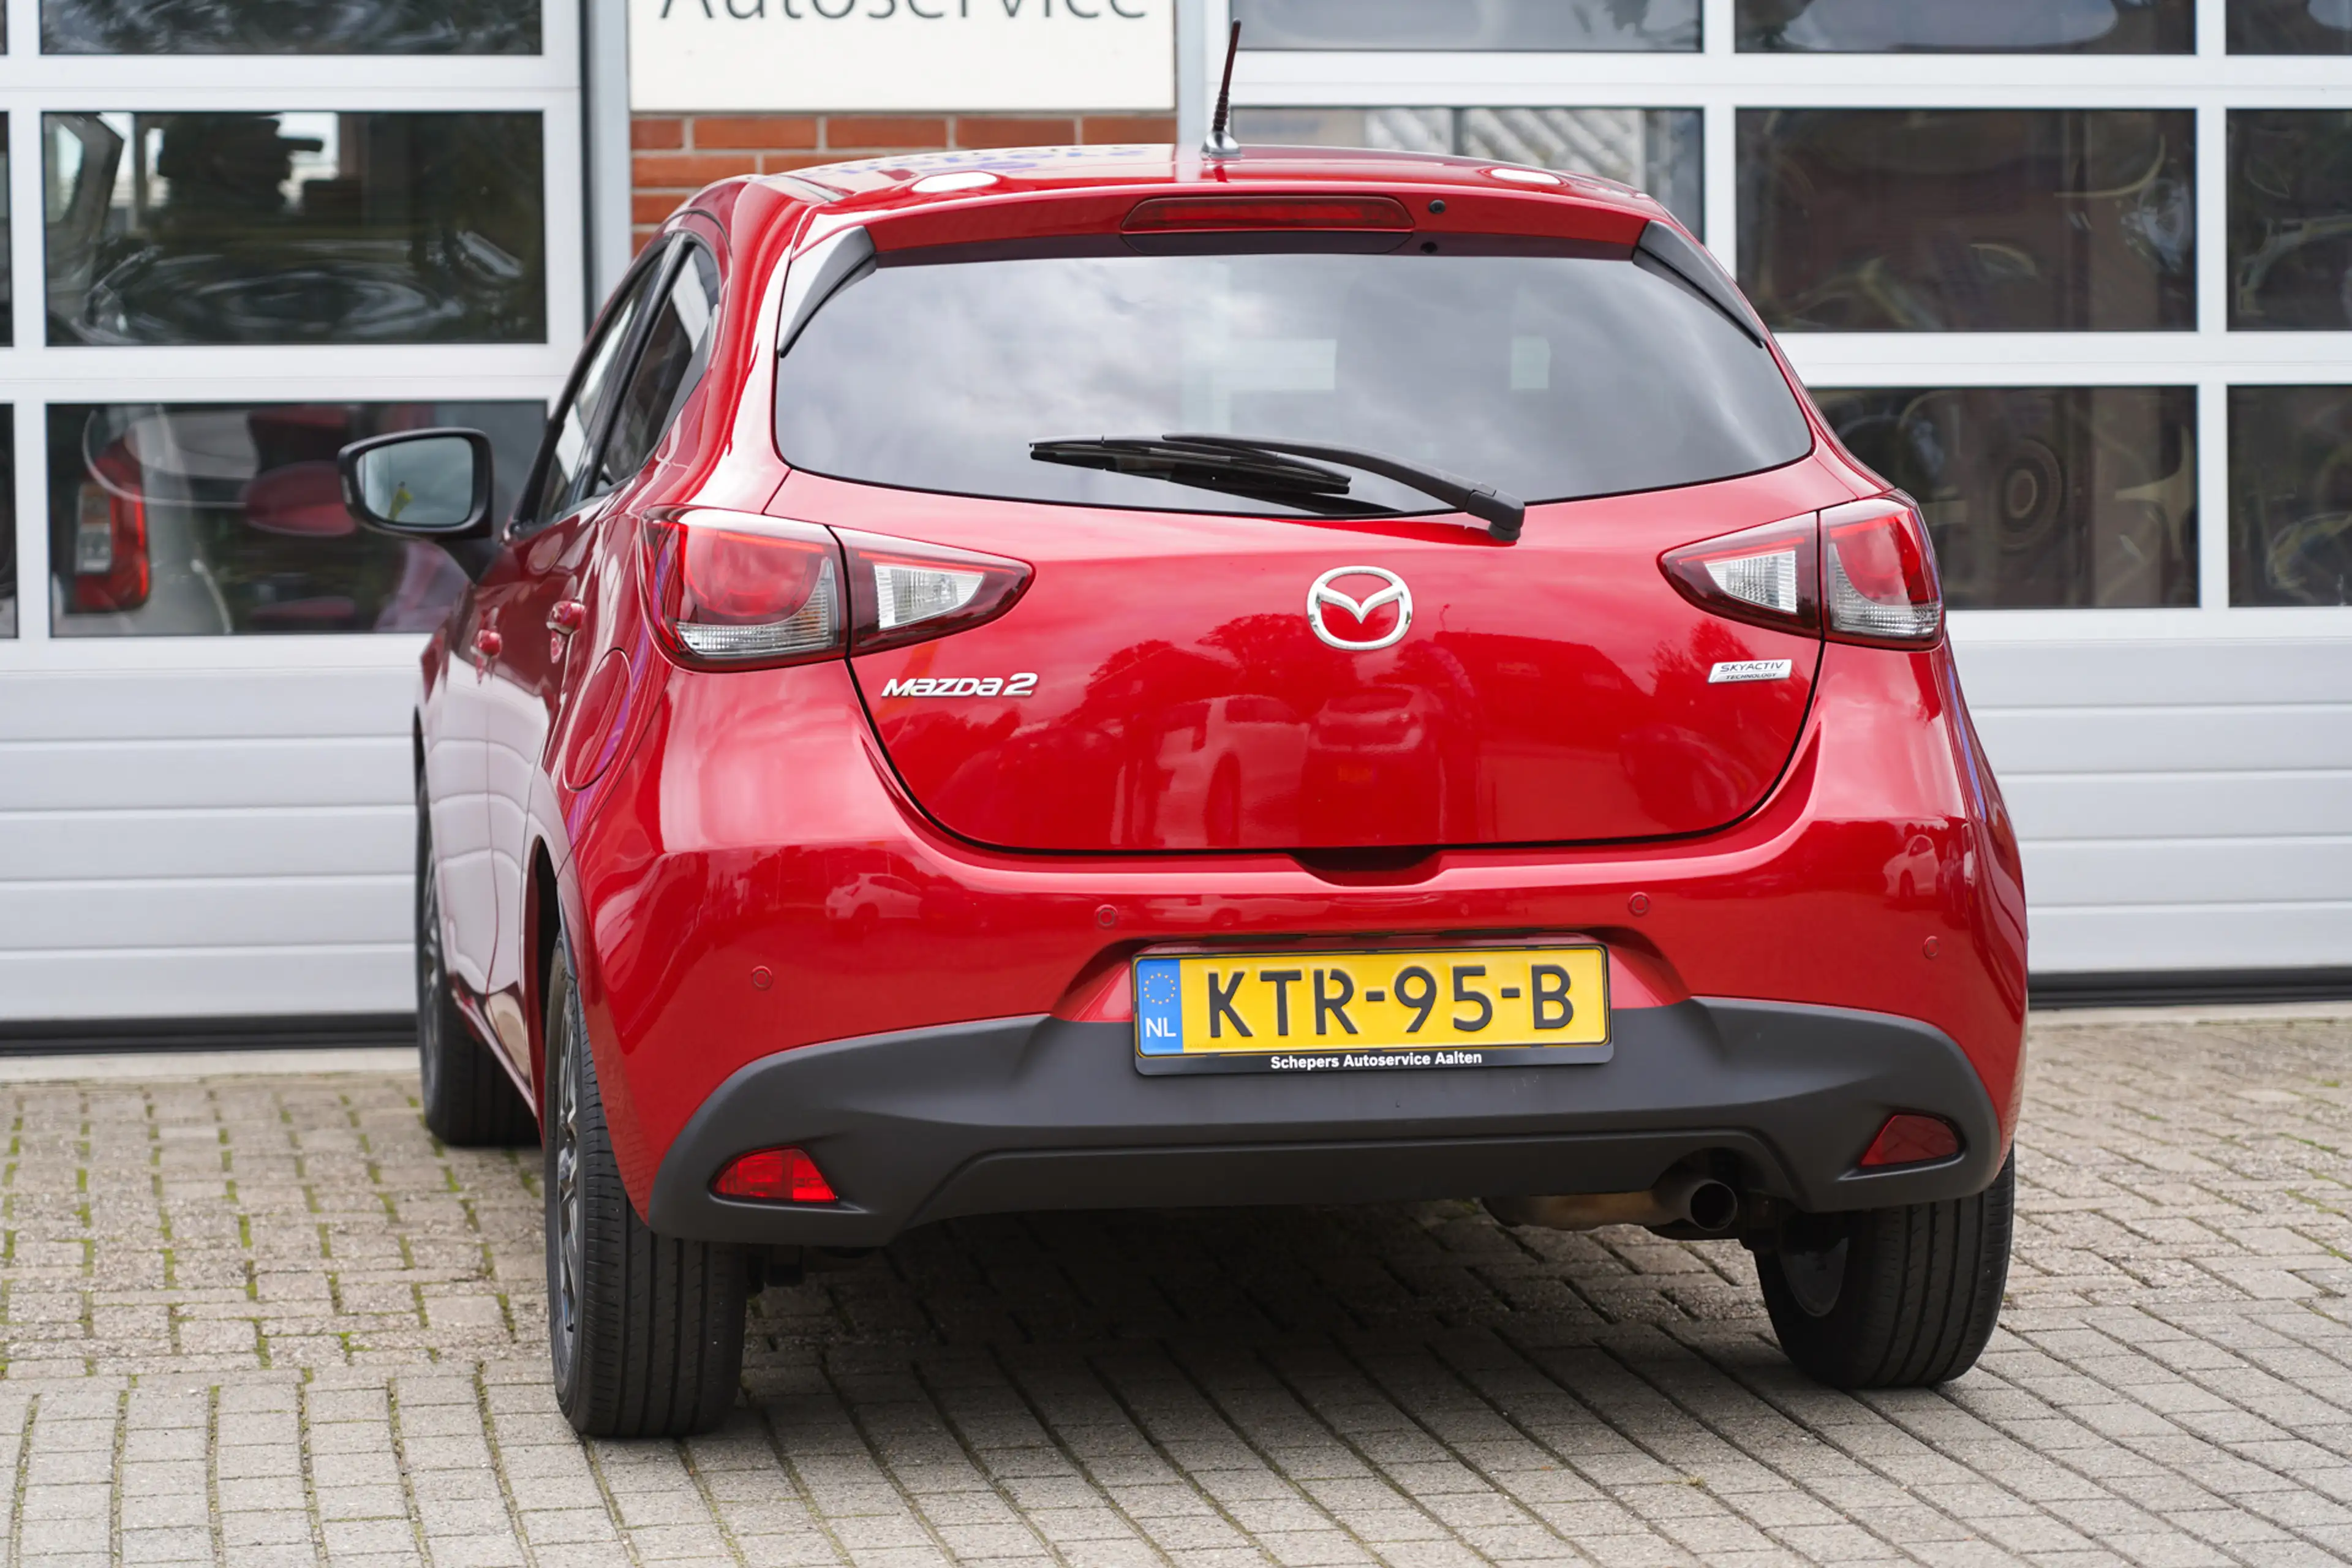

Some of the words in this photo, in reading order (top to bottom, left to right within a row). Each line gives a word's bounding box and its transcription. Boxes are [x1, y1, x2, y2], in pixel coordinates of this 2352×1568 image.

[1720, 662, 1784, 673] SKYACTIV
[1208, 964, 1575, 1038] KTR-95-B
[1145, 1017, 1177, 1038] NL
[1270, 1055, 1340, 1071] Schepers
[1343, 1052, 1431, 1067] Autoservice
[1434, 1050, 1483, 1065] Aalten
